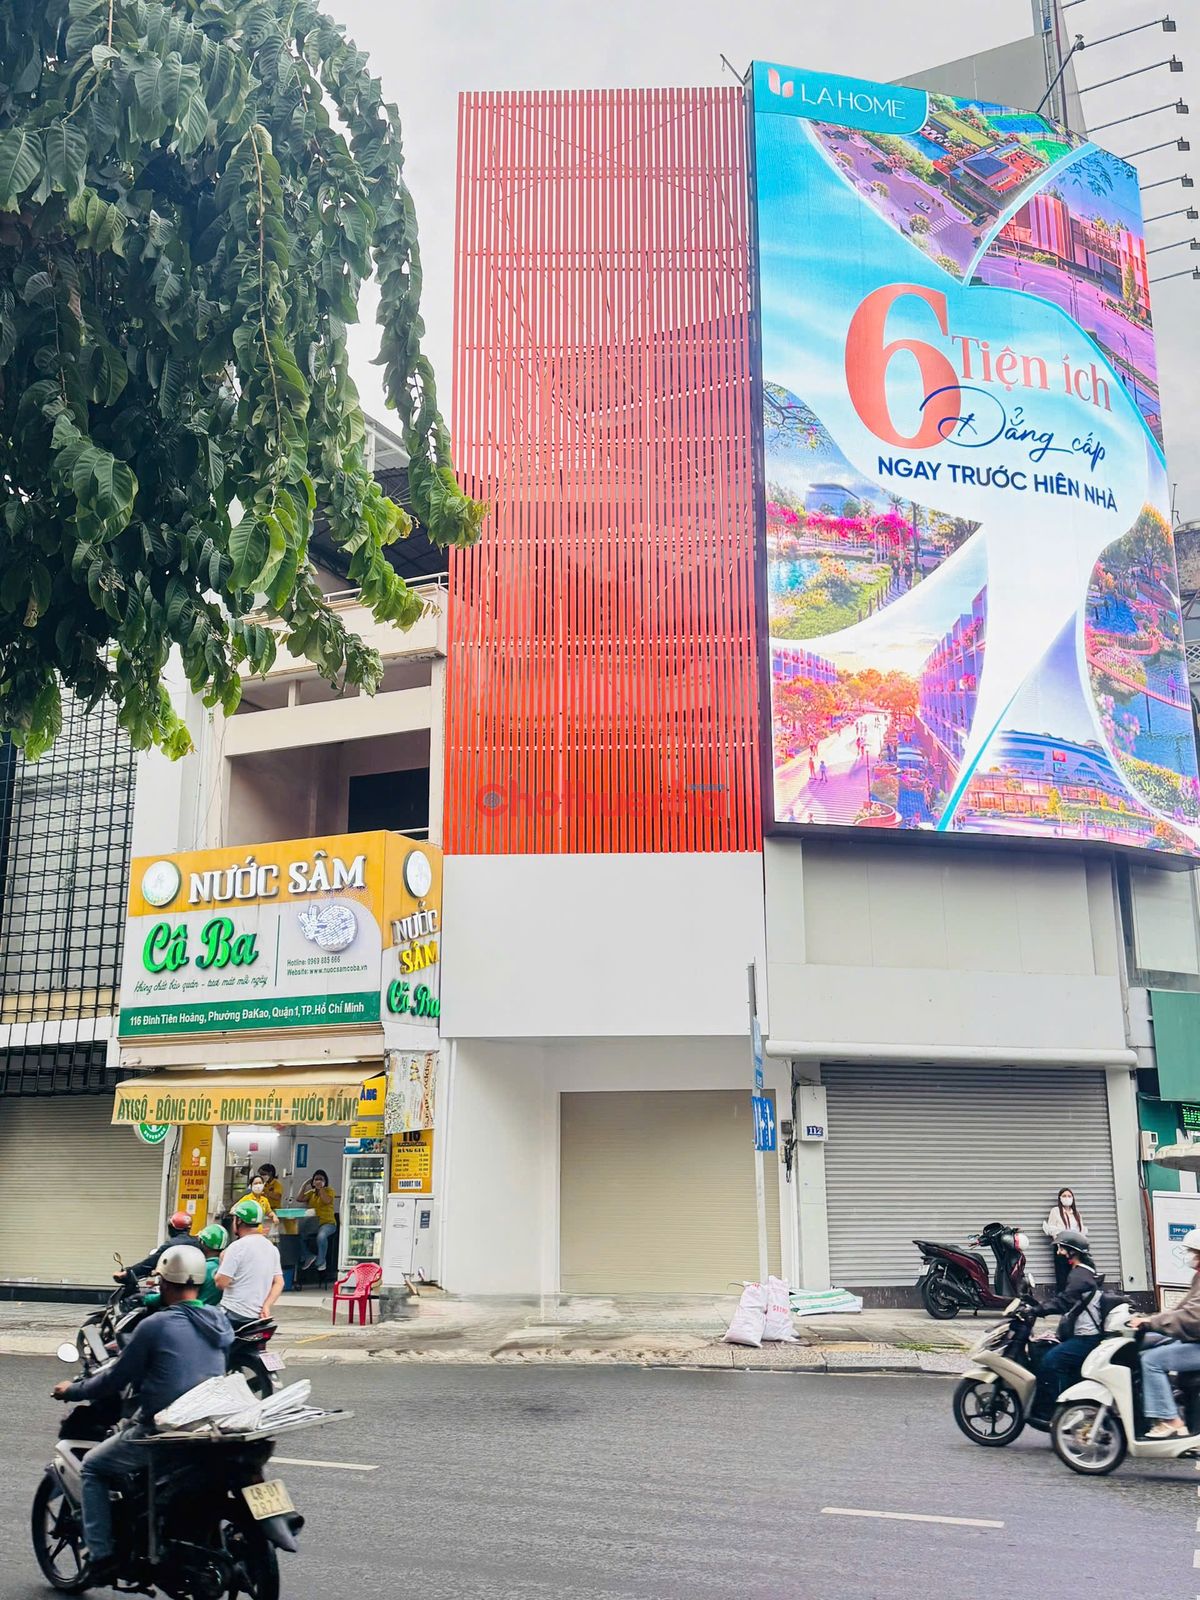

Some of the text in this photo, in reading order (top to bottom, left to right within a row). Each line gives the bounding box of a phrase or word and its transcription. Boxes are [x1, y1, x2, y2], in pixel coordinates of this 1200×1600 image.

[838, 90, 906, 119] HOME
[844, 282, 961, 450] 6
[951, 335, 1112, 412] Tiện ích
[919, 385, 1106, 472] Đẳng cấp
[877, 455, 1118, 513] NGAY TRƯỚC HIÊN NHÀ
[188, 849, 367, 904] NƯỚC SÂM
[142, 916, 260, 974] Cô Ba
[391, 900, 438, 945] NƯỚC
[399, 940, 439, 975] SÂM
[130, 1016, 141, 1026] 116
[161, 1013, 178, 1024] Tiên
[328, 1000, 343, 1014] Chí
[344, 1001, 365, 1013] Minh
[387, 978, 440, 1019] Cô Ba
[117, 1094, 148, 1121] ATISÔ
[155, 1095, 186, 1121] BÔNG
[187, 1092, 211, 1121] CÚC
[220, 1097, 250, 1121] RONG
[253, 1089, 283, 1121] BIỂN
[291, 1092, 324, 1121] NƯỚC
[326, 1089, 359, 1121] ĐẮNG
